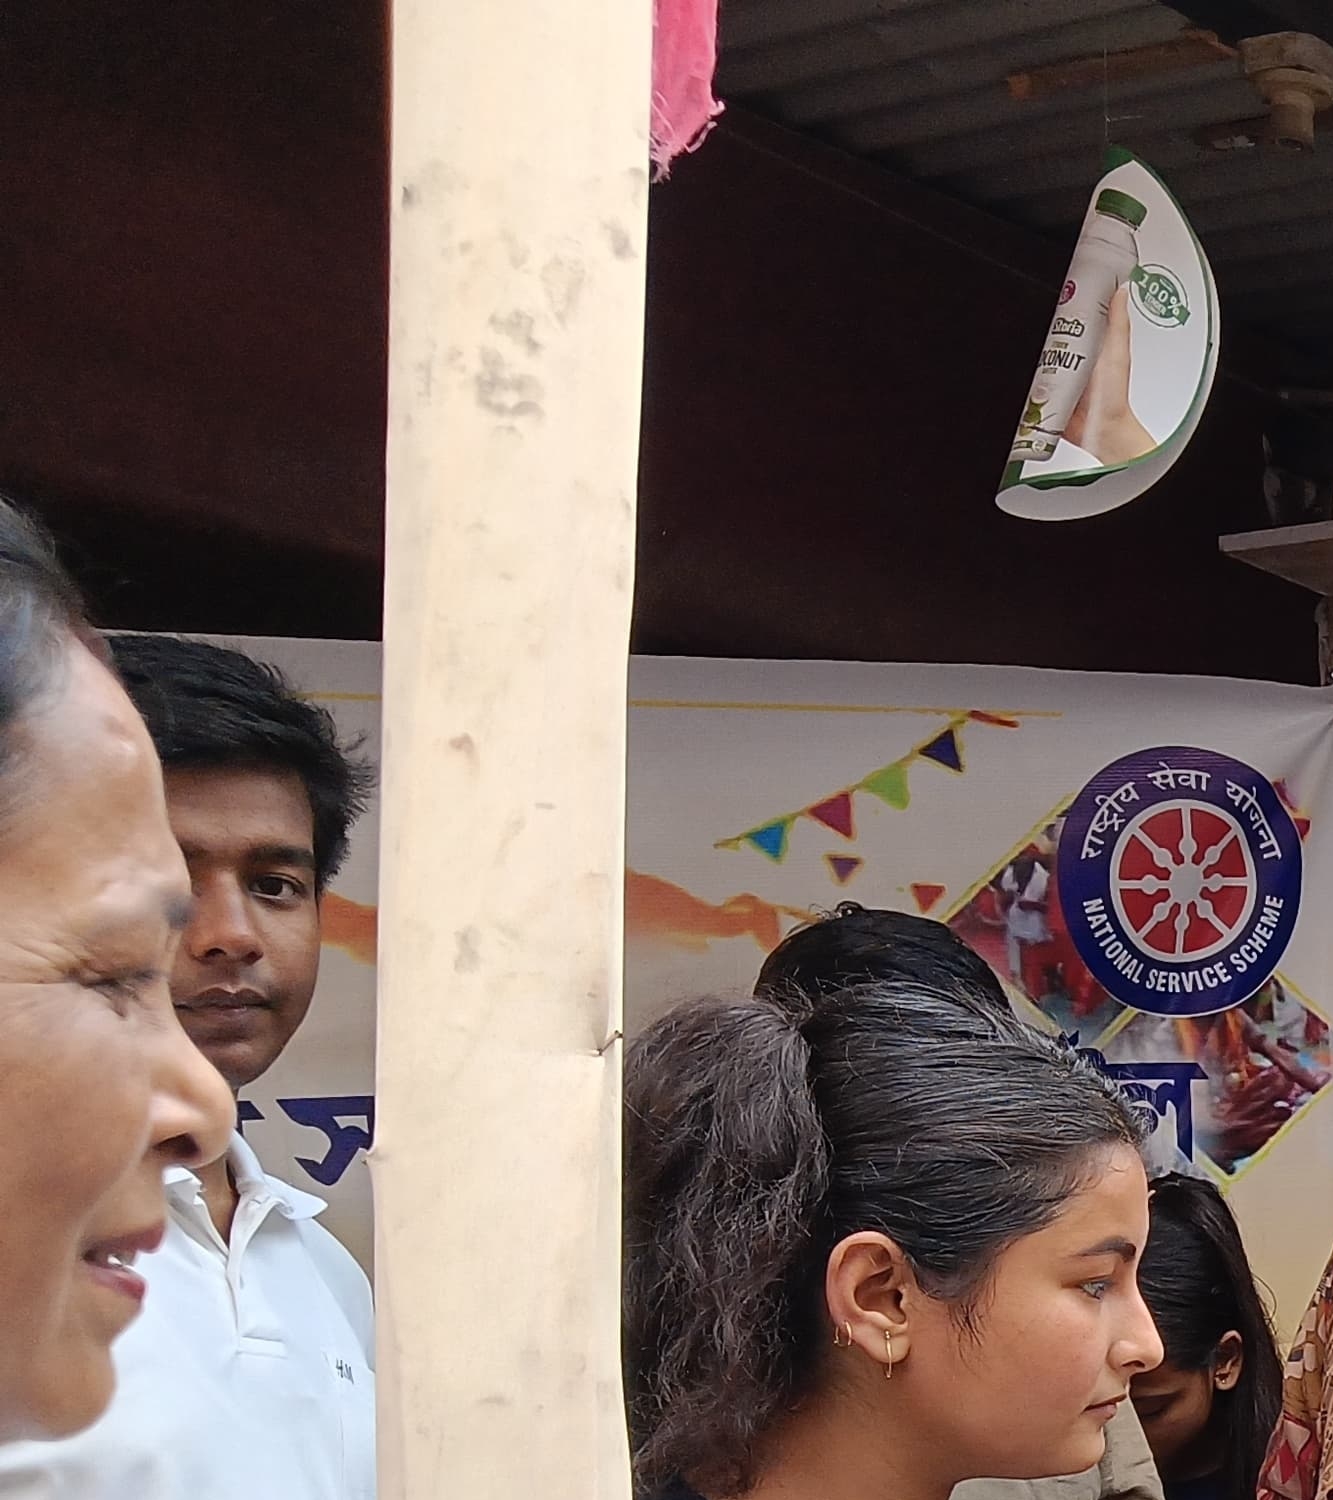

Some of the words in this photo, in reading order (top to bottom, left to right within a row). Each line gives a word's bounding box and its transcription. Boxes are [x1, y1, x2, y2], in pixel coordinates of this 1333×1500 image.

[1138, 272, 1181, 317] 100%
[1080, 782, 1140, 860] राष्ट्रीय
[1147, 761, 1211, 792] सेवा
[1225, 779, 1282, 860] योजना
[1083, 898, 1146, 984] NATIONAL
[1146, 961, 1233, 993] SERVICE
[1229, 895, 1284, 974] SCHEME
